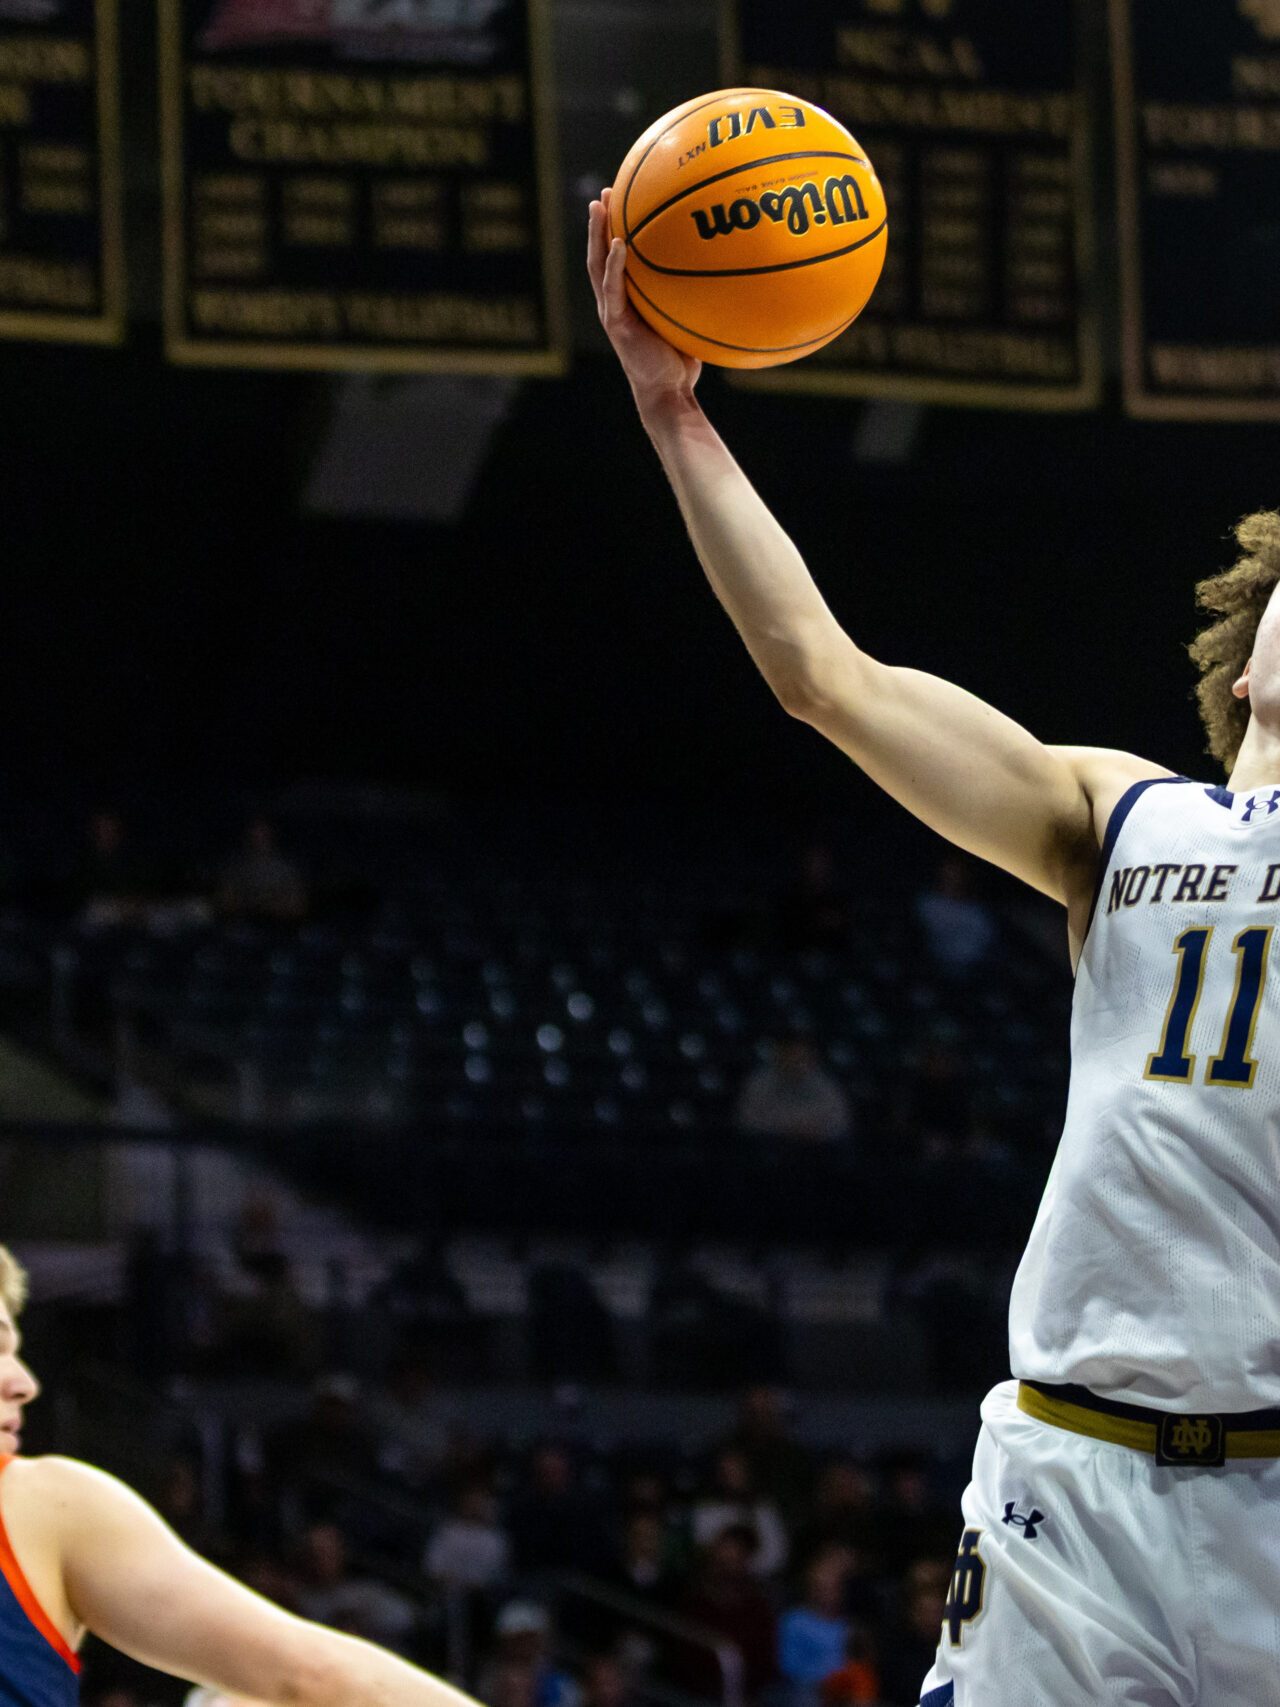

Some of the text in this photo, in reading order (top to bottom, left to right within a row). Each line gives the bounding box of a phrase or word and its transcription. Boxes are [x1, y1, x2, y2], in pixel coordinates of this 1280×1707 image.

[689, 174, 869, 241] Wilson
[1106, 863, 1239, 916] NOTRE
[1142, 925, 1275, 1089] 11
